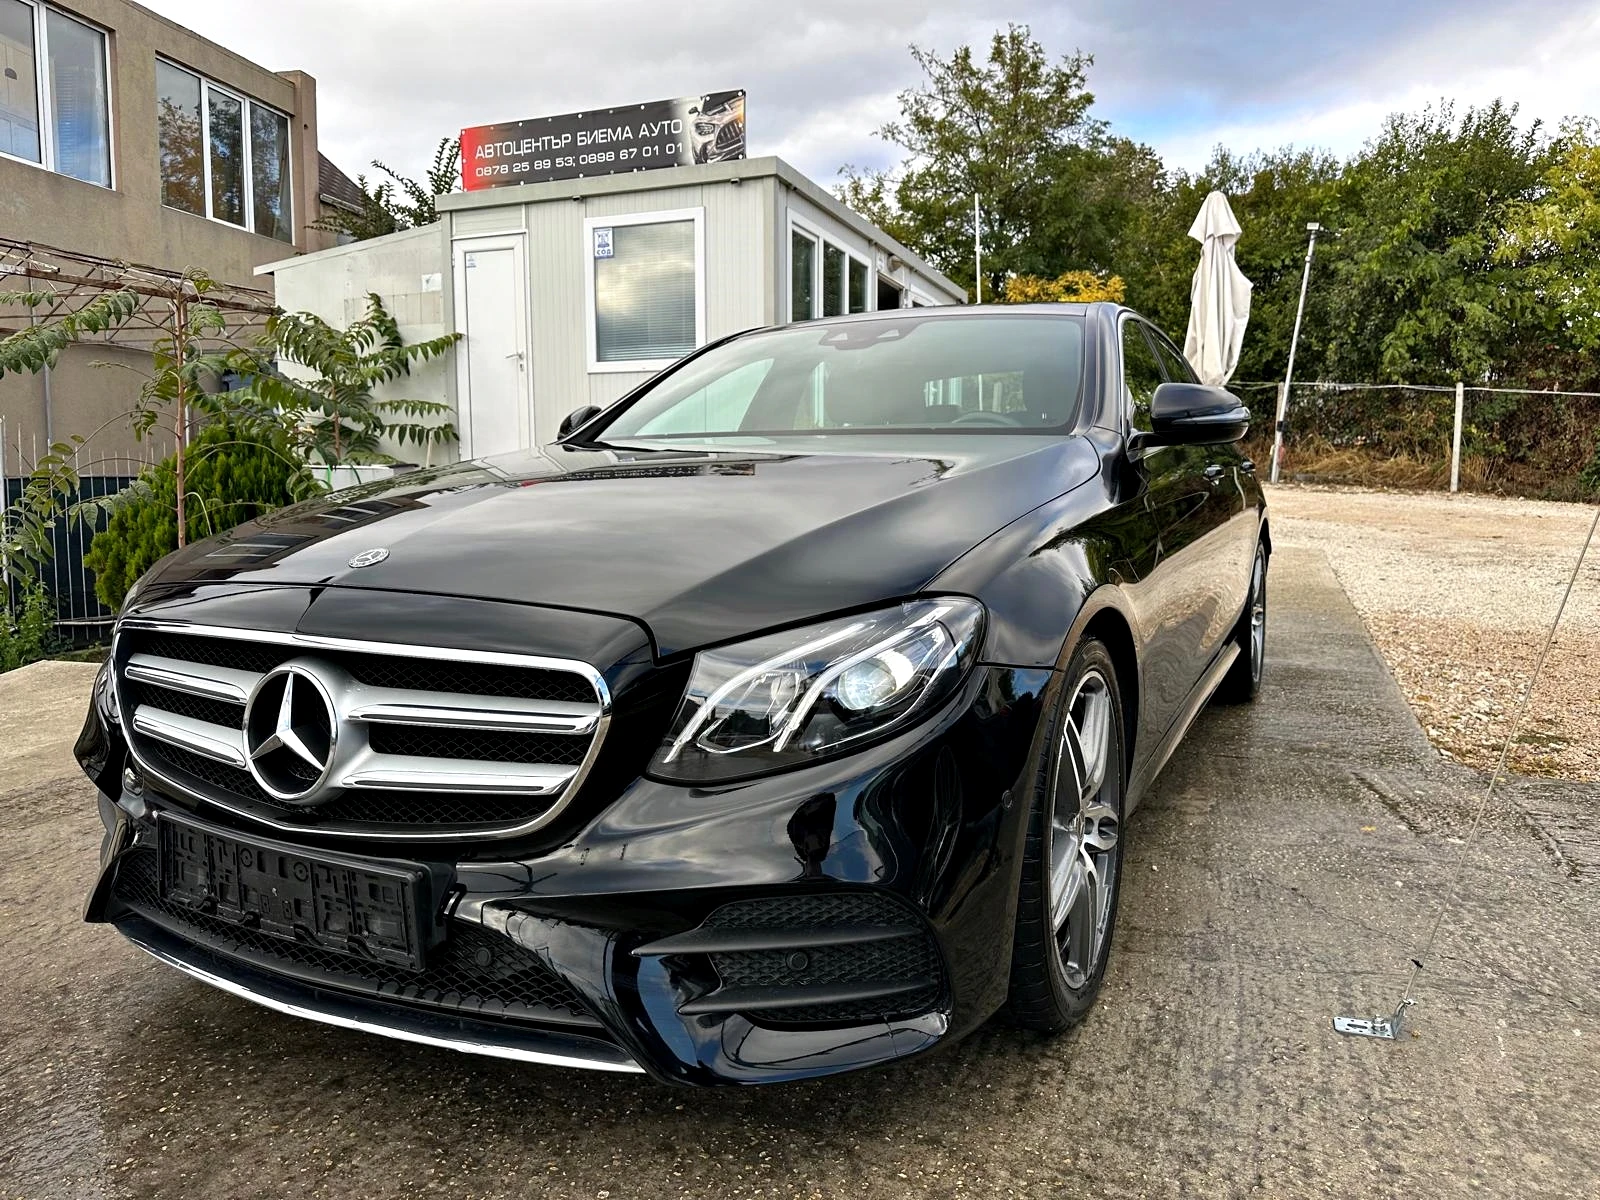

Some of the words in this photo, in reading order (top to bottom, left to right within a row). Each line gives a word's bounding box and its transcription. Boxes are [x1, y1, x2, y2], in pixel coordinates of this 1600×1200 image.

[475, 133, 571, 159] АВТОЦЕНТЪР
[577, 125, 633, 146] БИЕМА
[638, 119, 682, 138] АУТО
[475, 164, 509, 177] 0878
[512, 162, 530, 173] 25
[534, 159, 551, 170] 89
[579, 151, 615, 165] 0898
[619, 147, 638, 160] 67
[643, 144, 659, 157] 01
[665, 142, 682, 155] 01
